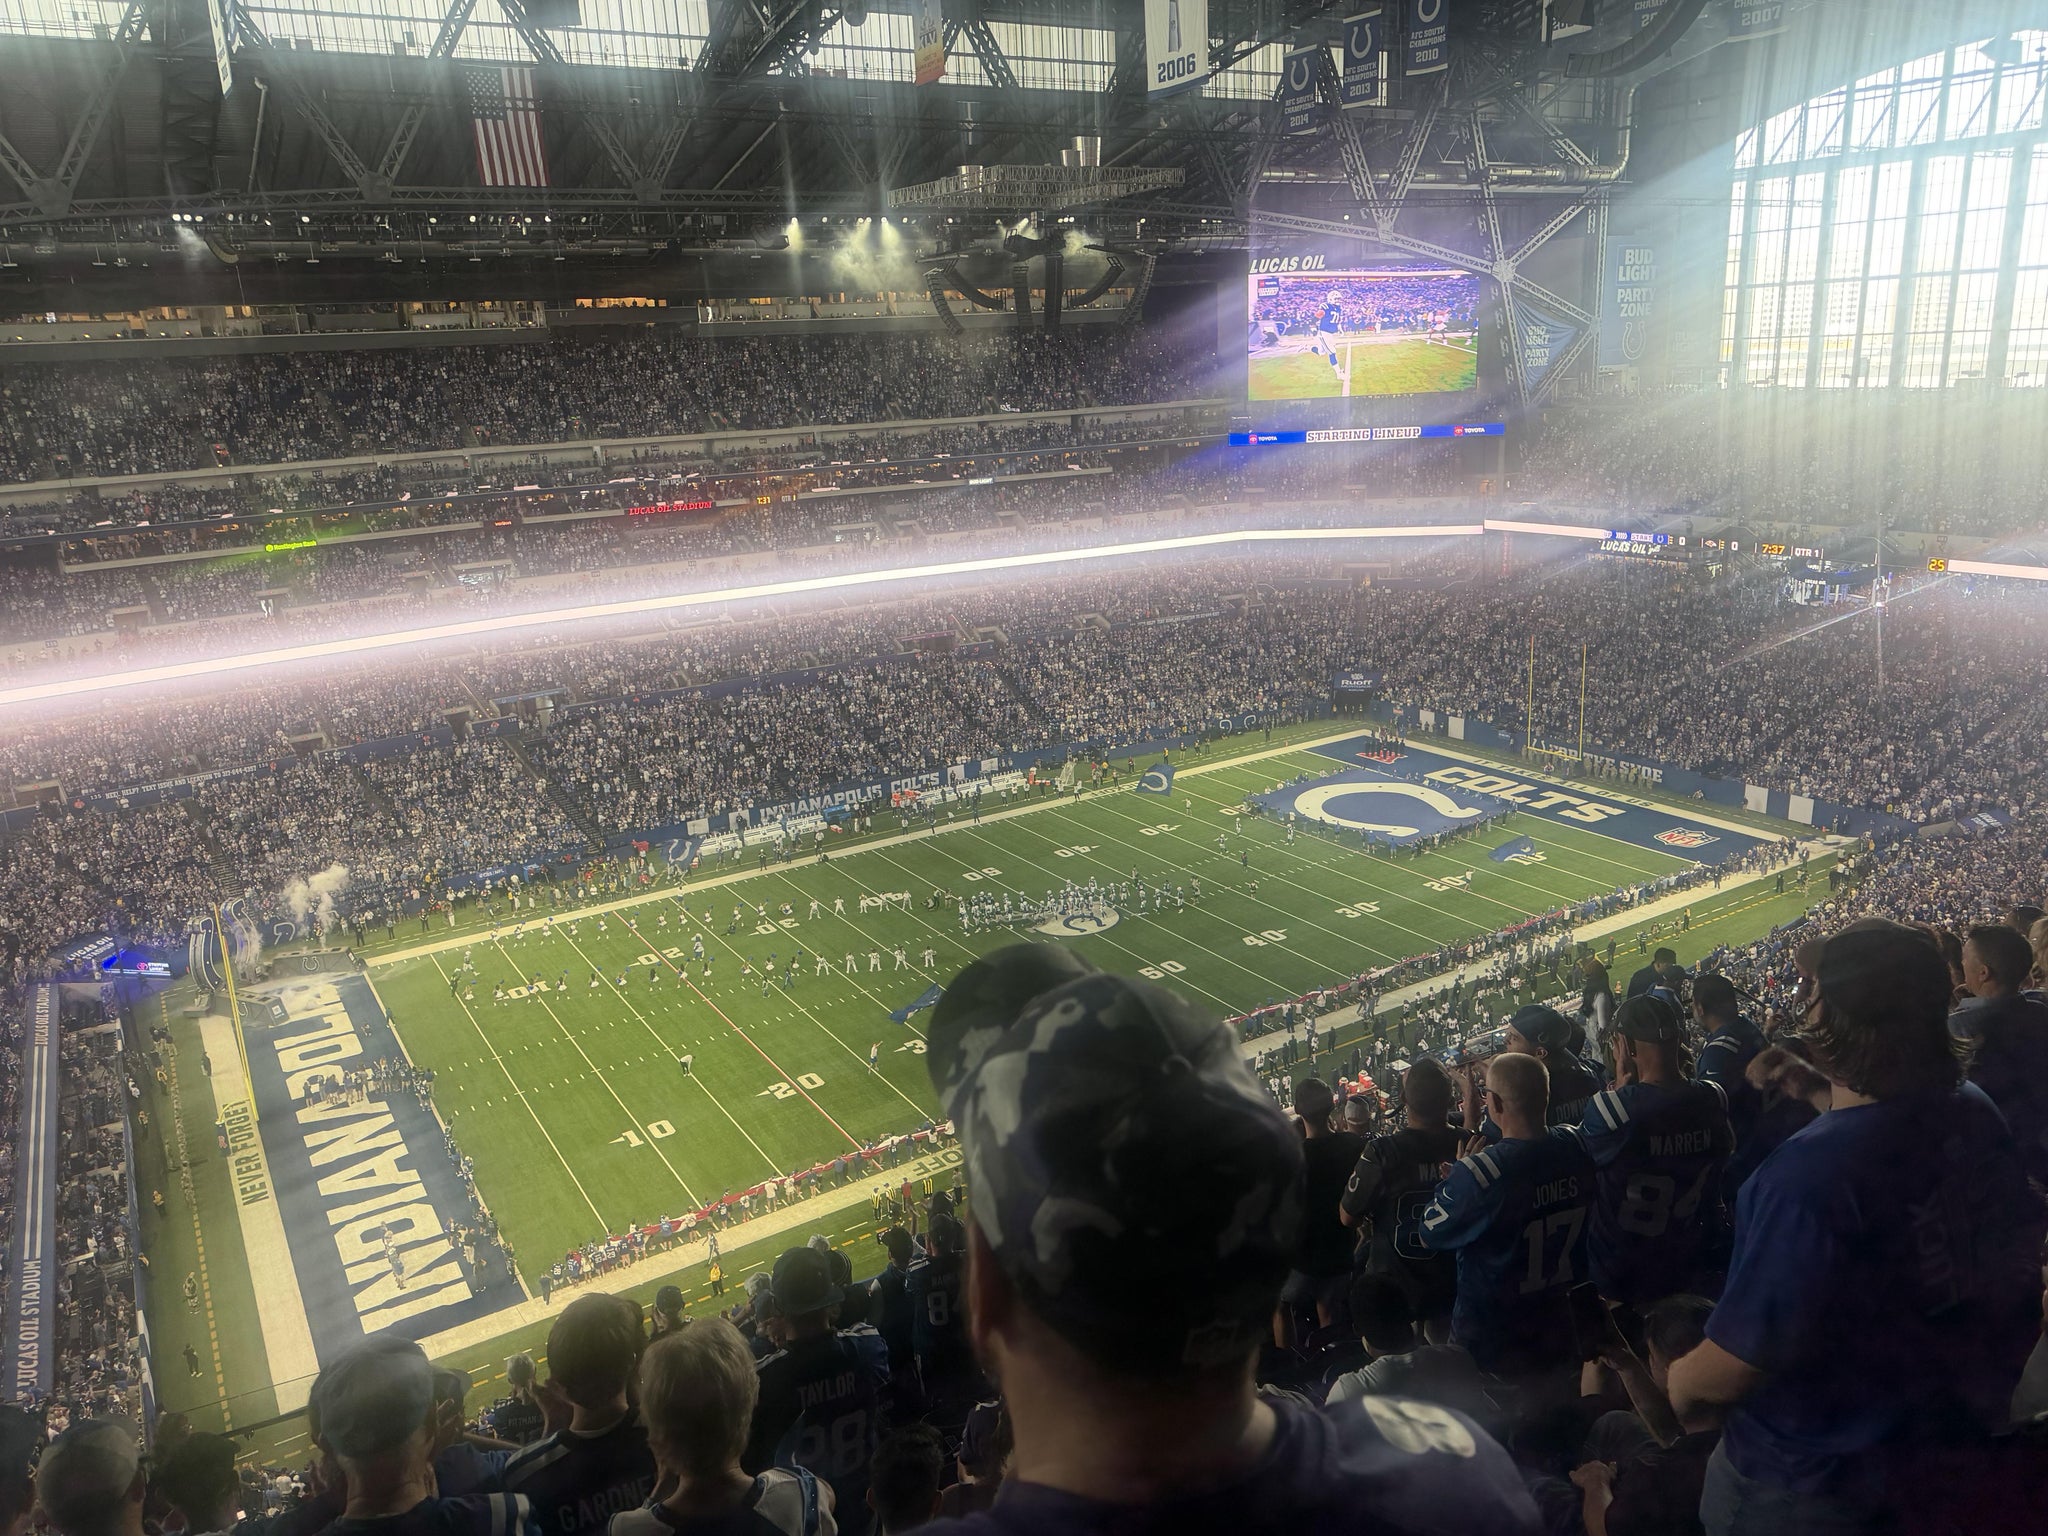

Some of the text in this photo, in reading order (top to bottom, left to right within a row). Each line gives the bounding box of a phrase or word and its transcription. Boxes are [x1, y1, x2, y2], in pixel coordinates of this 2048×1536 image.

[1742, 4, 1781, 26] 2007
[1409, 33, 1446, 49] CHAMPIONS
[1411, 26, 1446, 41] AFC SOUTH
[1416, 49, 1439, 63] 2010
[1157, 53, 1196, 83] 2006
[1343, 69, 1378, 83] CHAMPIONS
[1344, 62, 1377, 76] AFC SOUTH
[1350, 85, 1370, 97] 2013
[1284, 101, 1315, 114] CHAMPIONS
[1290, 114, 1309, 127] 2014
[1250, 255, 1325, 273] LUCAS OIL
[1625, 249, 1653, 265] BUD
[1618, 265, 1657, 282] LIGHT
[1617, 288, 1656, 303] PARTY
[1620, 304, 1651, 317] ZONE
[1525, 347, 1550, 358] PARTY
[1527, 357, 1548, 367] ZONE
[1307, 427, 1421, 442] STARTING LINEUP
[629, 501, 712, 515] LUCAS OIL STADIUM
[1600, 540, 1630, 553] LUCAS
[1631, 542, 1646, 555] OIL
[1679, 536, 1686, 546] 0
[1731, 541, 1738, 551] 0
[1761, 544, 1785, 554] 7:37
[1794, 547, 1819, 557] QTR 1
[1928, 558, 1945, 572] 25
[1620, 760, 1663, 783] SHOE
[760, 772, 941, 820] INDIANAPOLIS COLTS
[1424, 767, 1627, 822] COLTS
[1663, 832, 1700, 847] NFL
[1423, 875, 1463, 893] 20
[1334, 902, 1373, 919] 30
[1242, 929, 1278, 947] 40
[1138, 960, 1187, 980] 50
[767, 1072, 825, 1100] 20
[620, 1119, 677, 1149] 10
[1650, 1128, 1713, 1157] WARREN
[222, 1100, 270, 1206] NEVER FORGET
[1531, 1175, 1580, 1209] JONES
[1519, 1205, 1588, 1296] 17
[16, 1260, 42, 1388] LUCAS OIL STADIUM
[797, 1371, 857, 1410] TAYLOR
[558, 1474, 653, 1533] GARDNE
